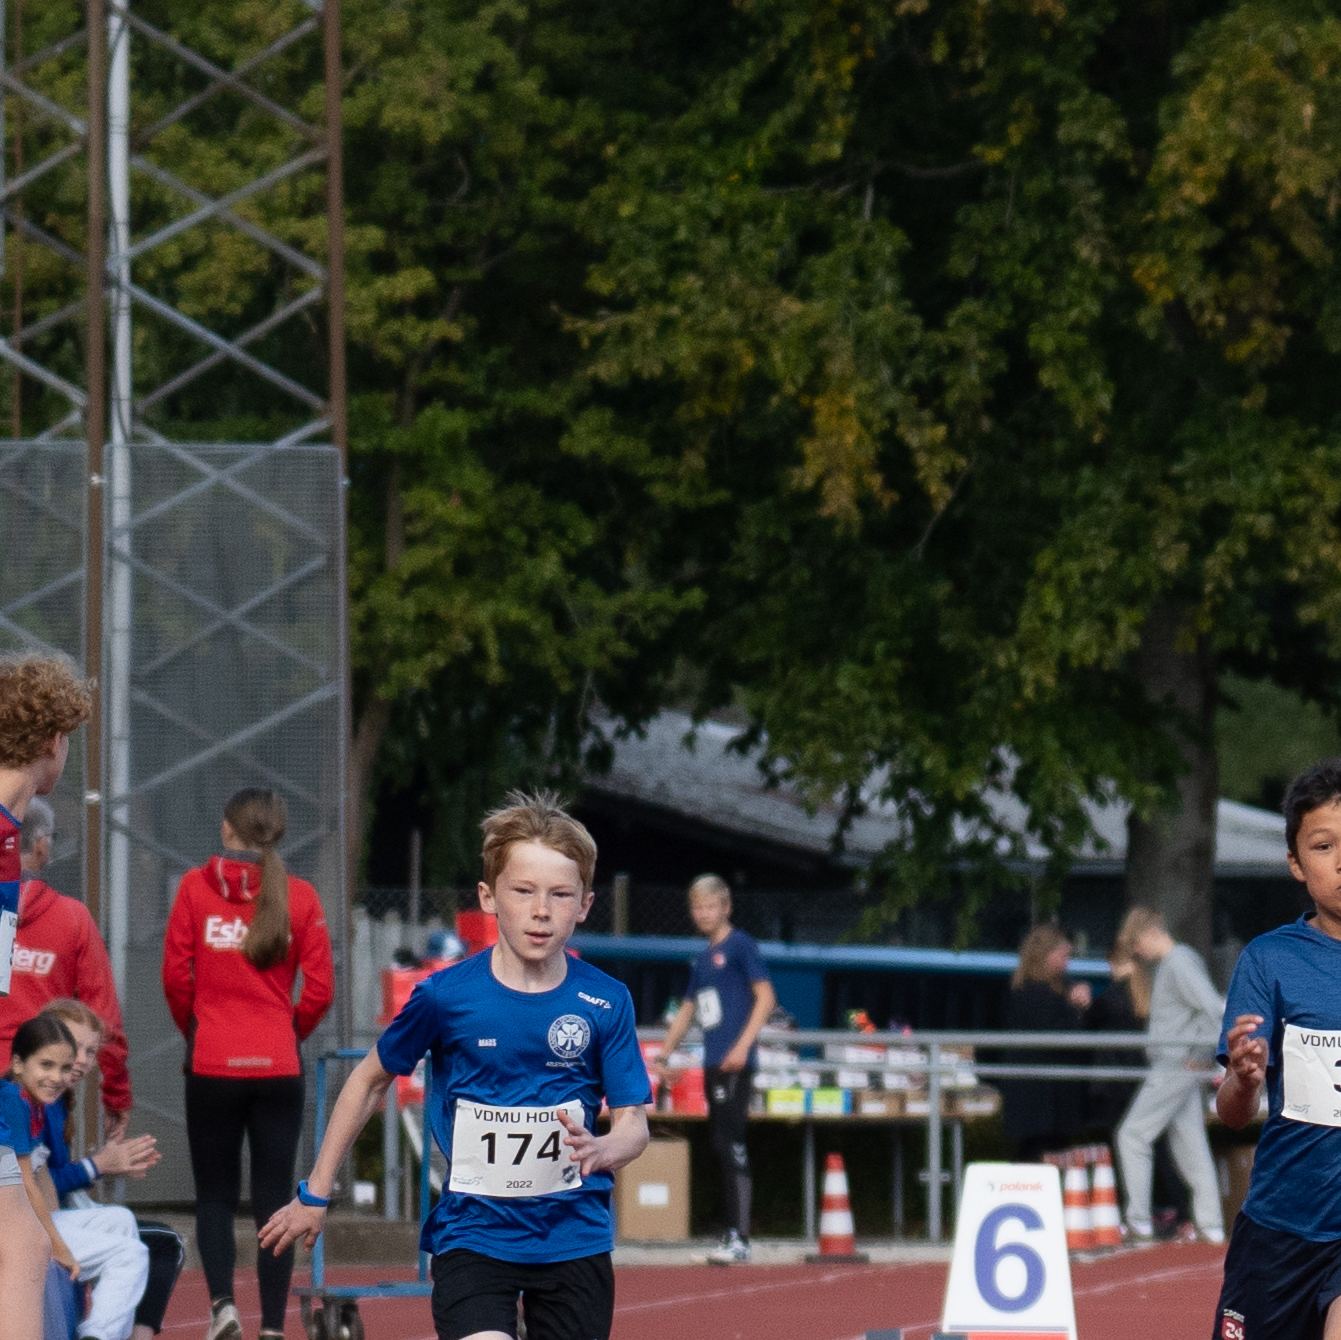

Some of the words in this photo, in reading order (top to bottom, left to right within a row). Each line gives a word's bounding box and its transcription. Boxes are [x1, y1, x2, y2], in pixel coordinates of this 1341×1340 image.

[473, 1107, 521, 1123] VDMU
[480, 1130, 562, 1166] 174
[506, 1180, 533, 1189] 2022
[974, 1202, 1047, 1314] 6
